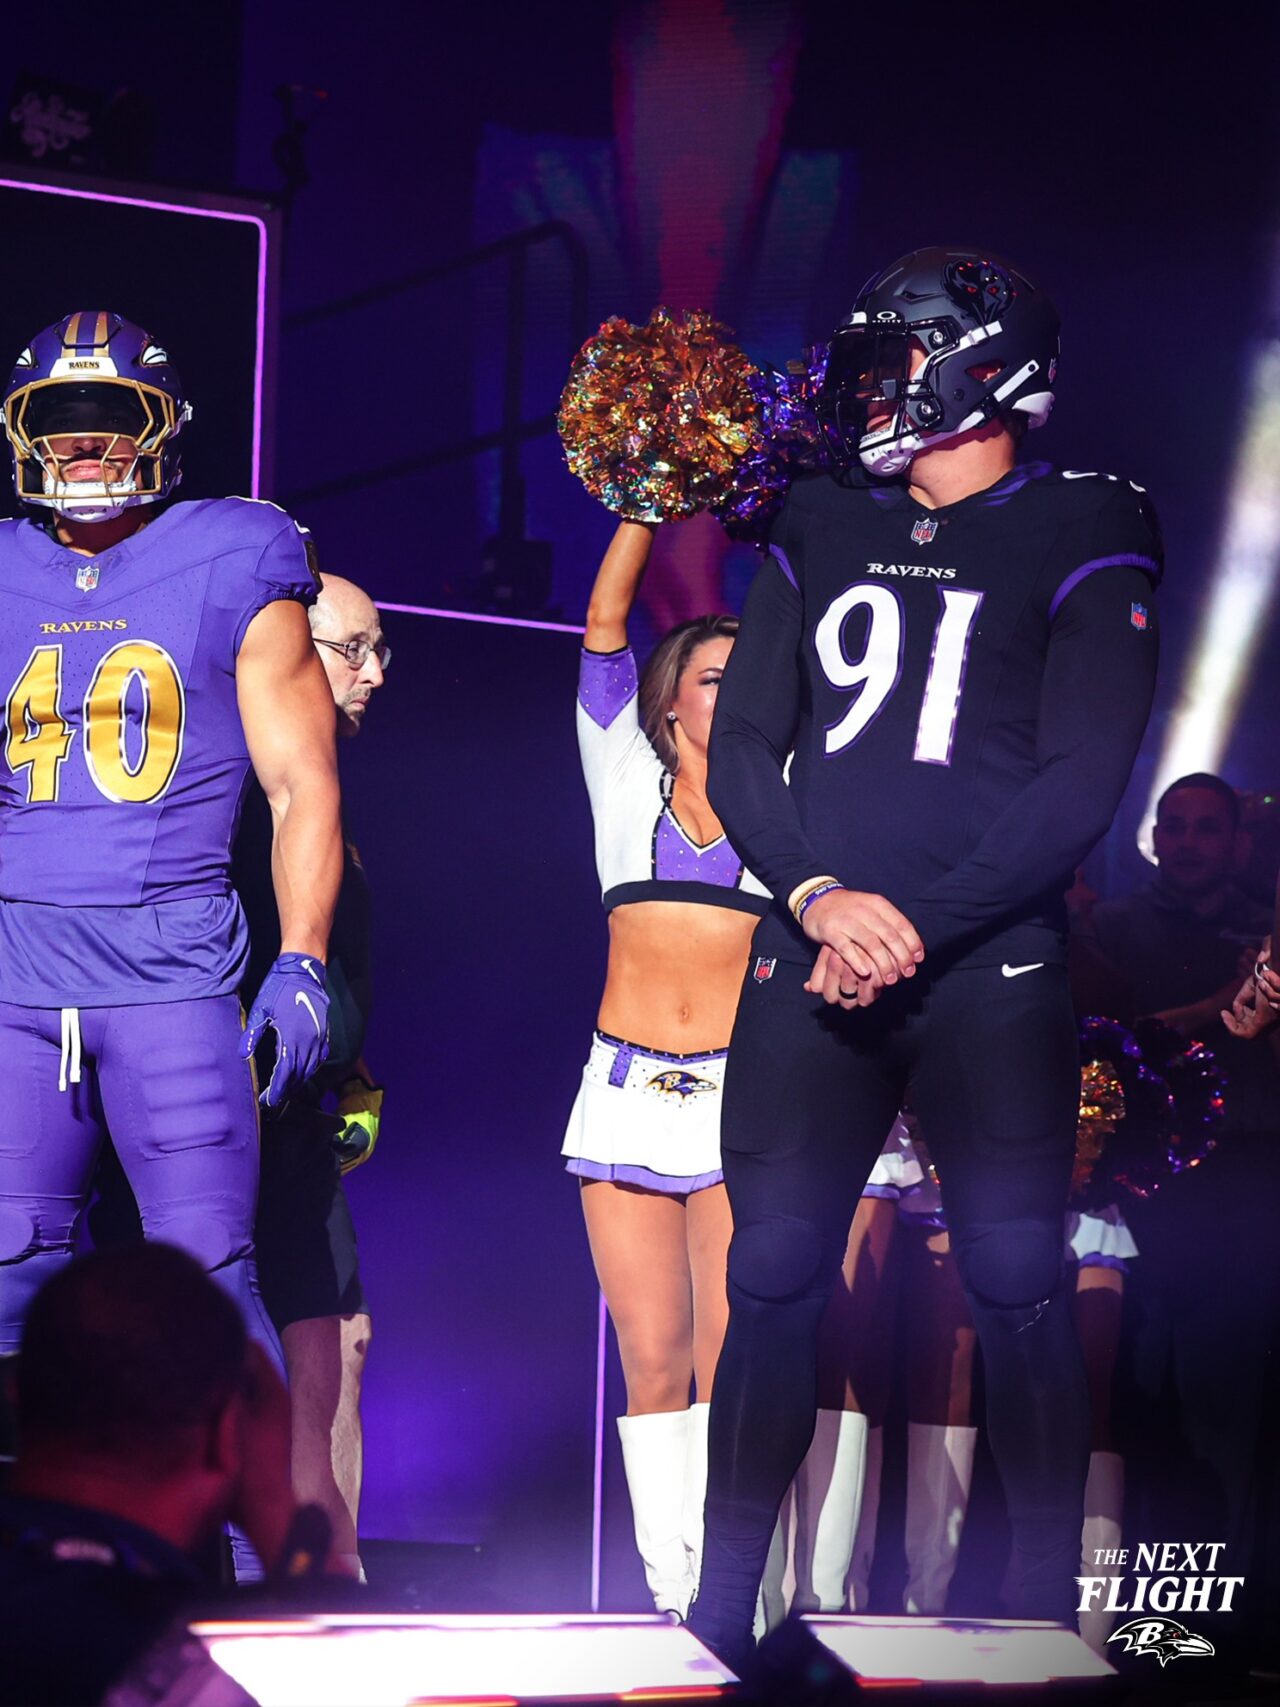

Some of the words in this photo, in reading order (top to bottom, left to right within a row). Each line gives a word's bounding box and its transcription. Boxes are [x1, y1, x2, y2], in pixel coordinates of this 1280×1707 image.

[68, 361, 100, 370] RAVENS
[866, 562, 957, 579] RAVENS
[39, 618, 128, 634] RAVENS
[813, 580, 986, 768] 91
[5, 639, 186, 804] 40
